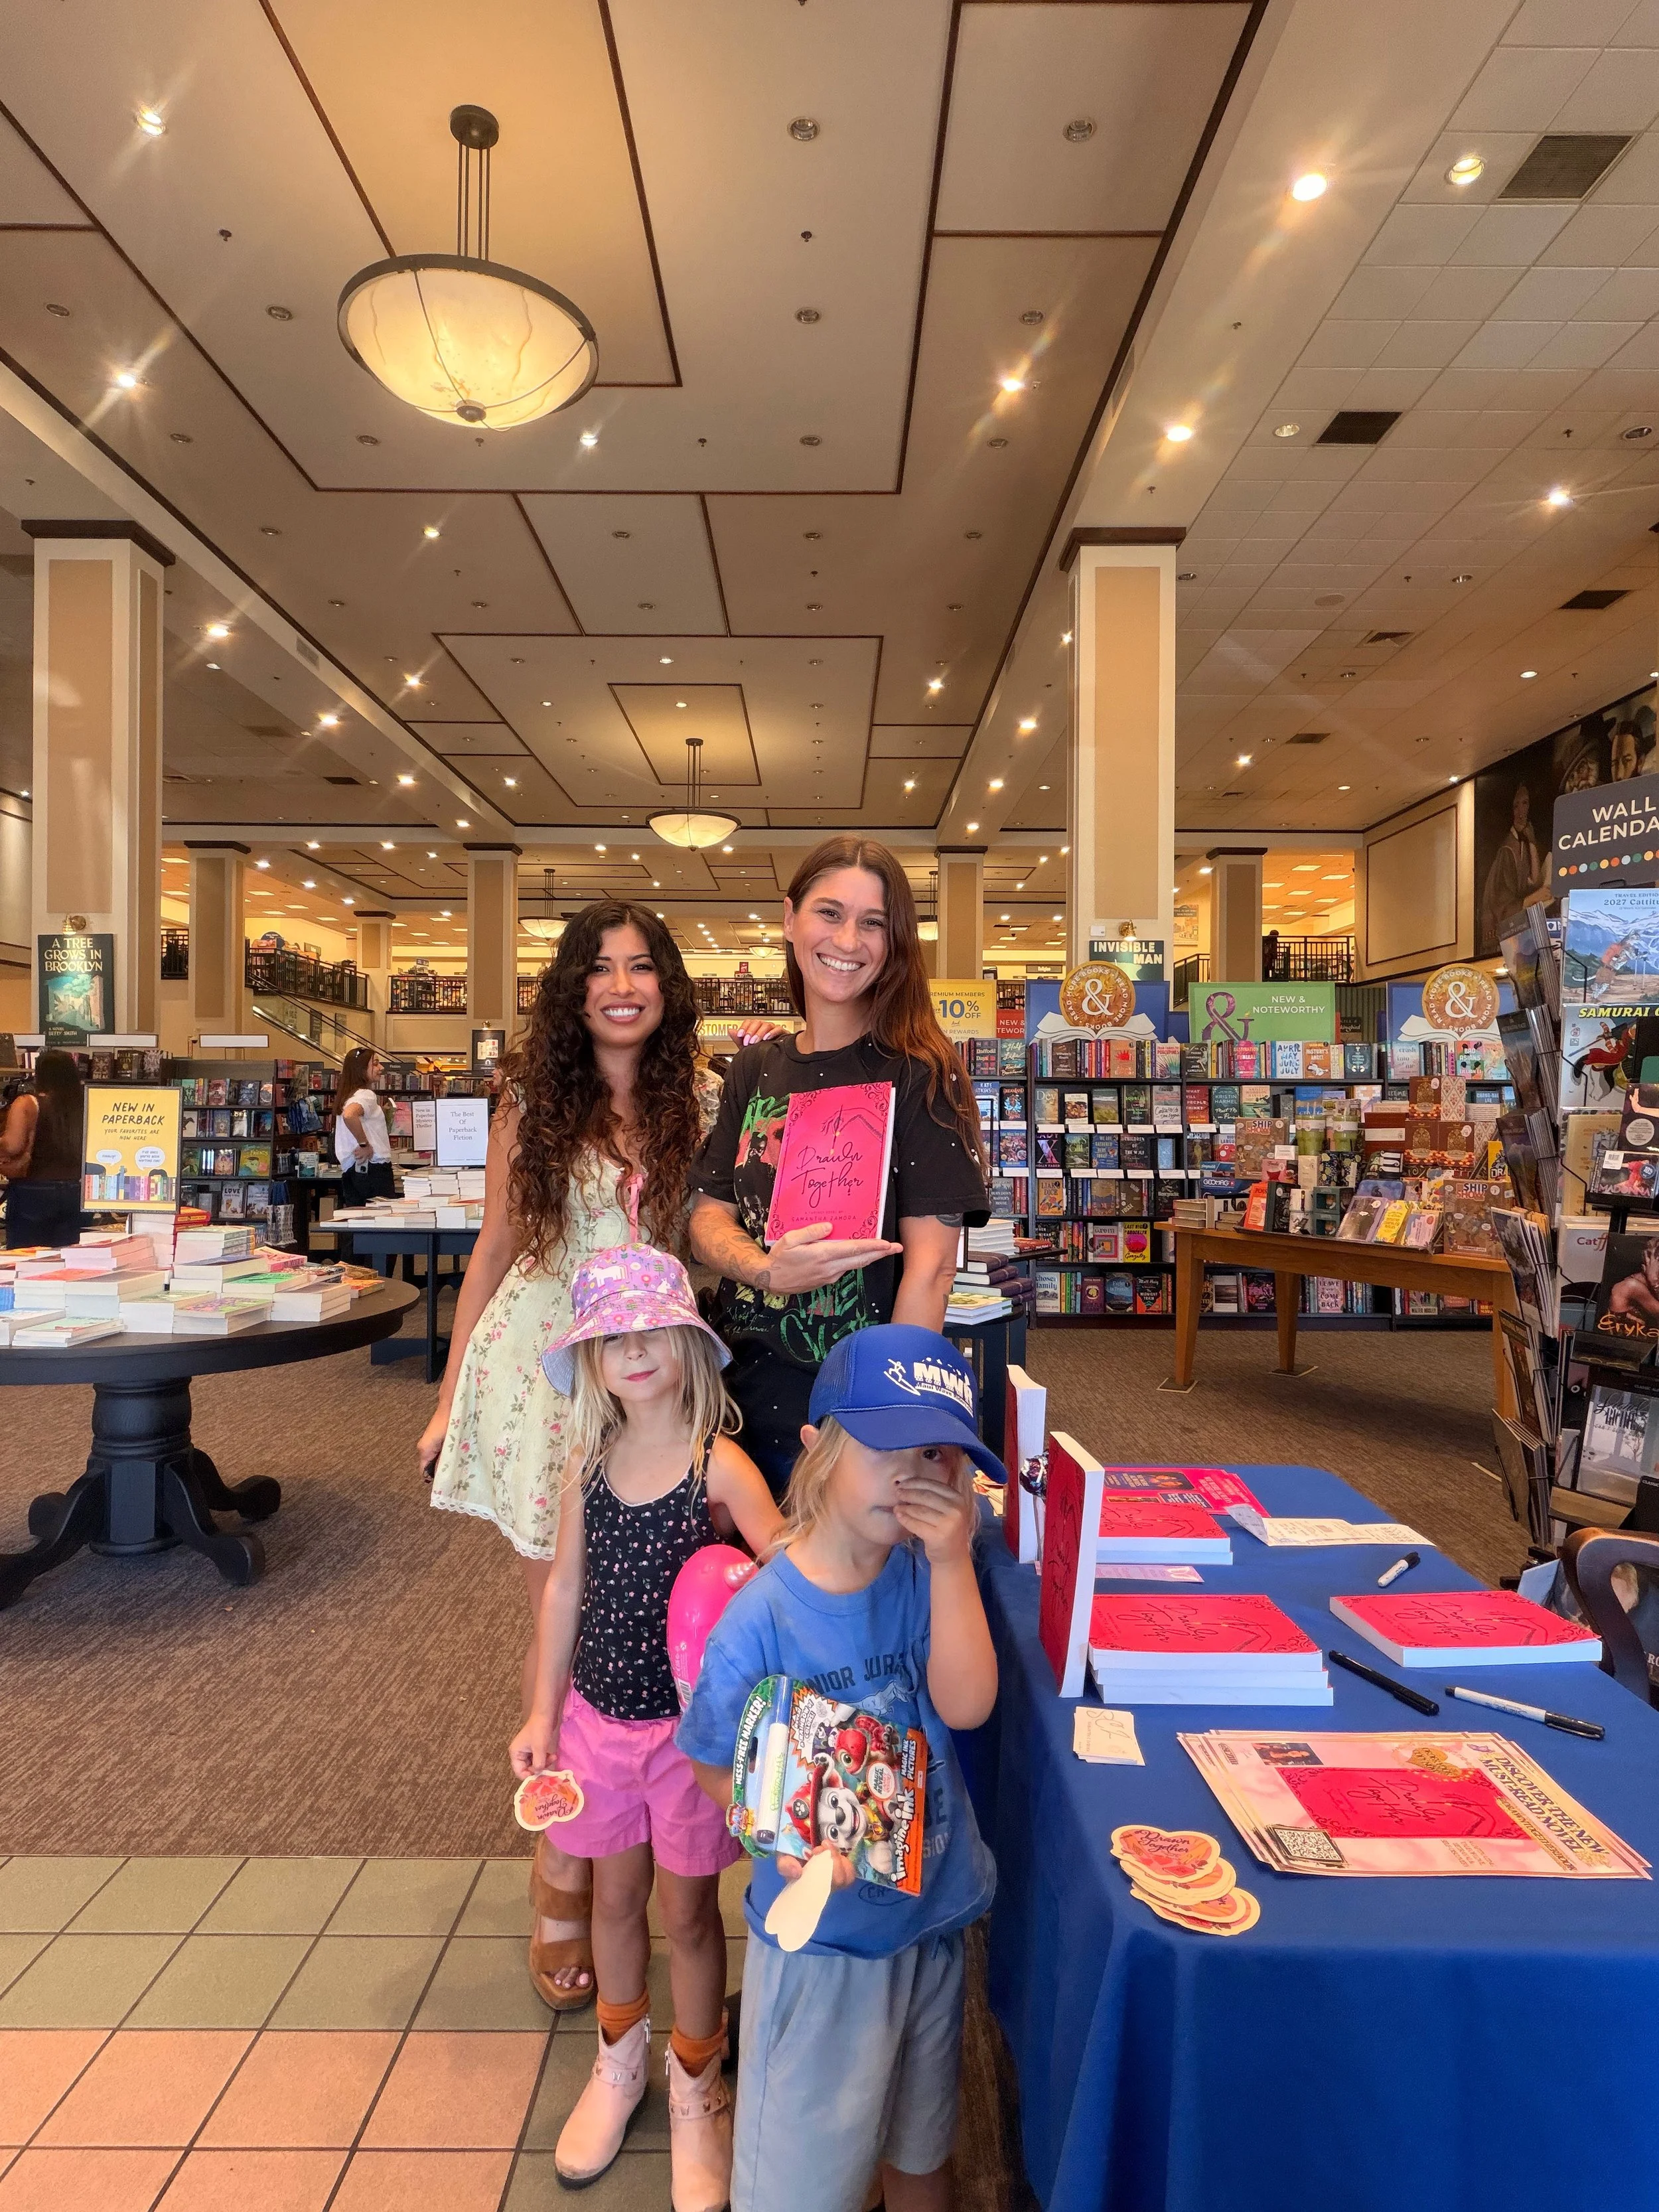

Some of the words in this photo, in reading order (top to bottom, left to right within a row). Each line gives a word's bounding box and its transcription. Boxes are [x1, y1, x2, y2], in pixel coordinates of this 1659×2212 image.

[1592, 796, 1656, 823] WALL
[52, 938, 60, 948] A
[64, 938, 93, 948] TREE
[1094, 942, 1155, 952] INVISIBLE
[44, 950, 86, 961] GROWS
[90, 950, 102, 960] IN
[1133, 954, 1163, 964] MAN
[45, 962, 103, 973] BROOKLYN
[1081, 968, 1110, 977] BOOKS
[1444, 970, 1473, 980] BOOKS
[1067, 974, 1080, 997] MORE
[1116, 978, 1128, 999] READ
[1429, 979, 1443, 999] MORE
[1479, 980, 1492, 1001] READ
[1067, 1001, 1080, 1021] READ
[1114, 1001, 1128, 1023] MORE
[1429, 1003, 1443, 1023] READ
[1477, 1004, 1492, 1025] MORE
[1578, 1007, 1649, 1018] SAMURAI
[1085, 1021, 1113, 1030] BOOKS
[1449, 1023, 1477, 1033] BOOKS
[112, 1102, 138, 1112] NEW
[142, 1104, 155, 1112] IN
[102, 1115, 165, 1125] PAPERBACK
[797, 1142, 863, 1170] Drawn
[1037, 1140, 1060, 1163] X
[790, 1161, 863, 1209] Together
[1463, 1183, 1488, 1192] SHIP
[1456, 1191, 1485, 1201] SHOW
[741, 1696, 766, 1739] MARKER!
[798, 1706, 809, 1741] RAINBOW
[805, 1712, 816, 1739] COLORS!
[735, 1738, 749, 1785] MESS-FREE
[907, 1739, 916, 1781] PICTURES
[896, 1788, 915, 1822] ink
[1479, 1759, 1546, 1819] MUST-READ
[1537, 1816, 1585, 1853] NOVEL
[1494, 1757, 1554, 1806] DISCOVER
[1550, 1806, 1578, 1829] THE
[1571, 1825, 1609, 1854] NEW
[1134, 1829, 1190, 1844] Drawn
[1138, 1839, 1189, 1853] Together
[891, 1820, 910, 1883] imagine
